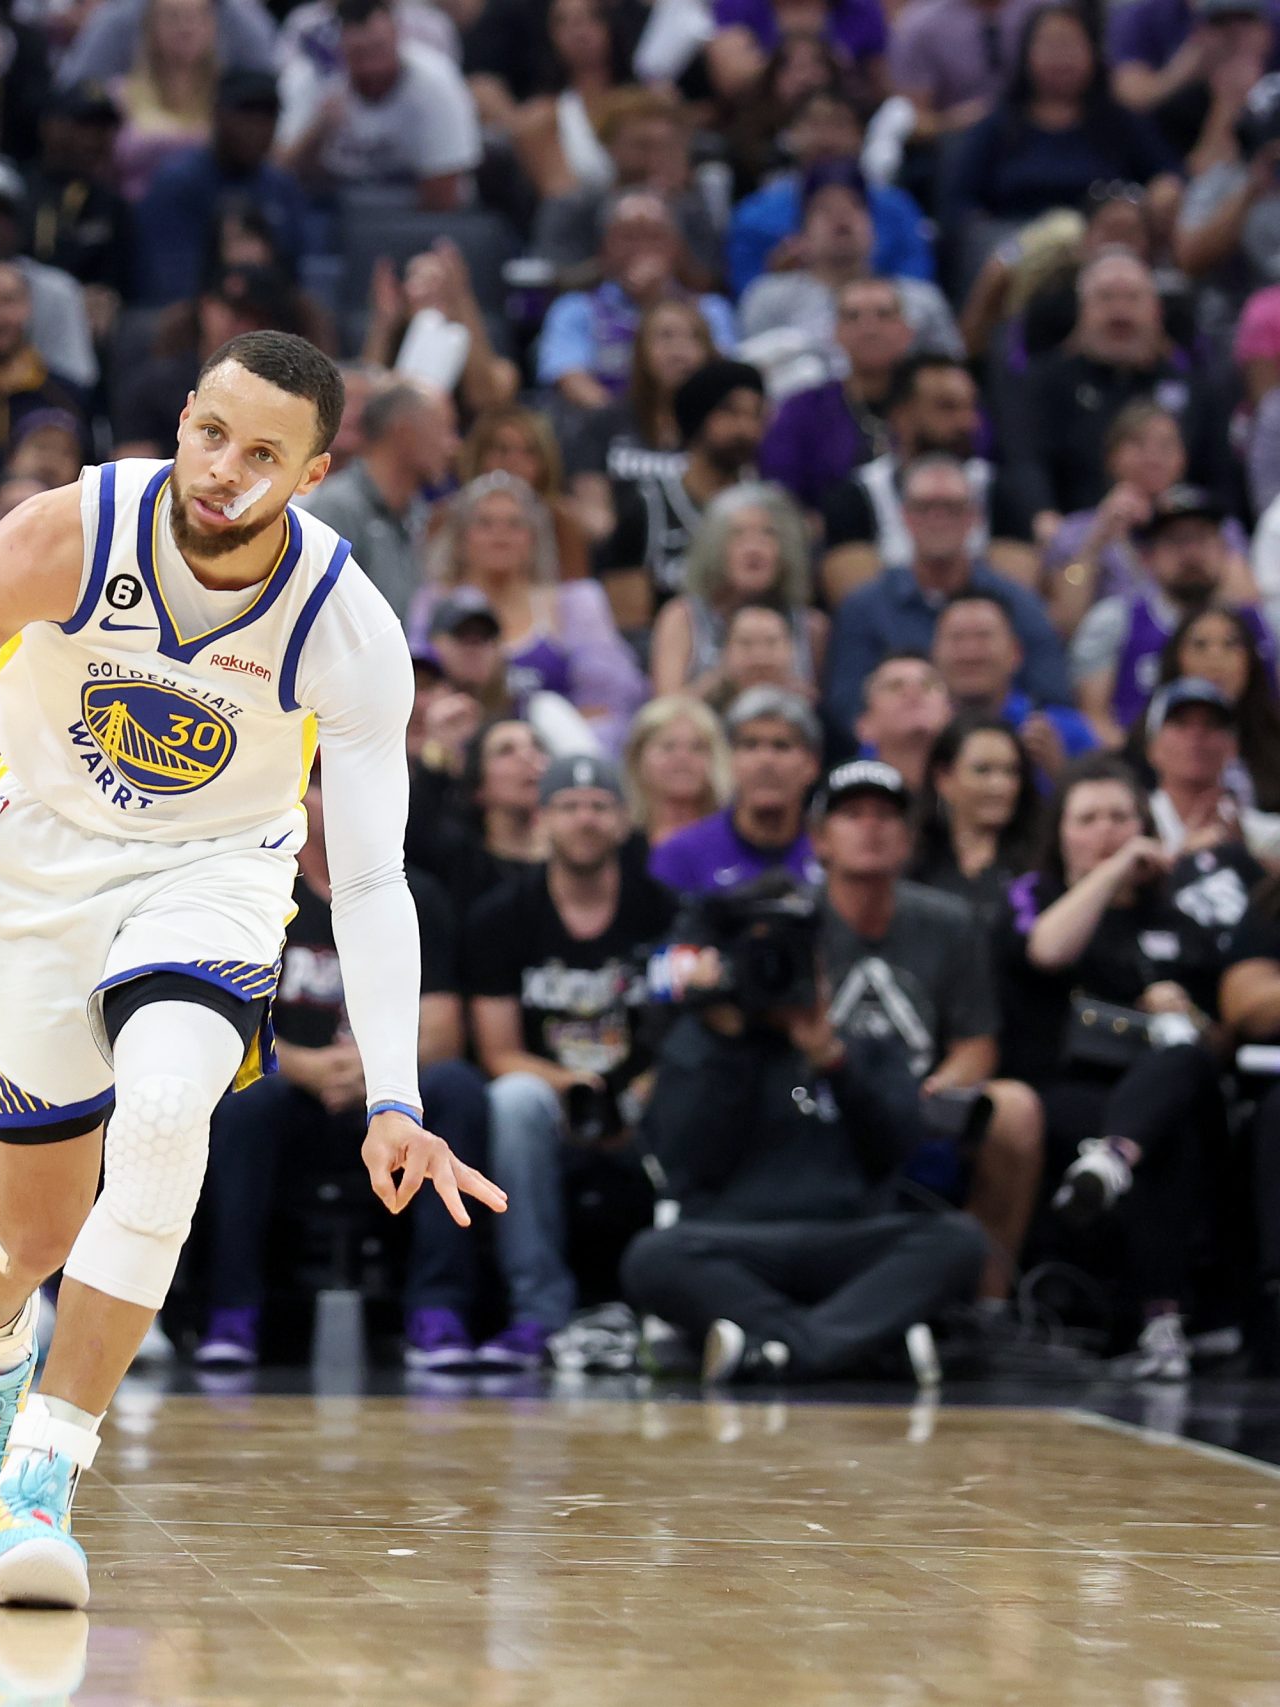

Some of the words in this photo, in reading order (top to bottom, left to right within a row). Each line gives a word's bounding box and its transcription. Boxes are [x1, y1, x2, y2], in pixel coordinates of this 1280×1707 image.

[112, 578, 136, 606] 6
[87, 661, 176, 687] GOLDEN
[210, 654, 272, 683] Rakuten
[161, 713, 222, 752] 30
